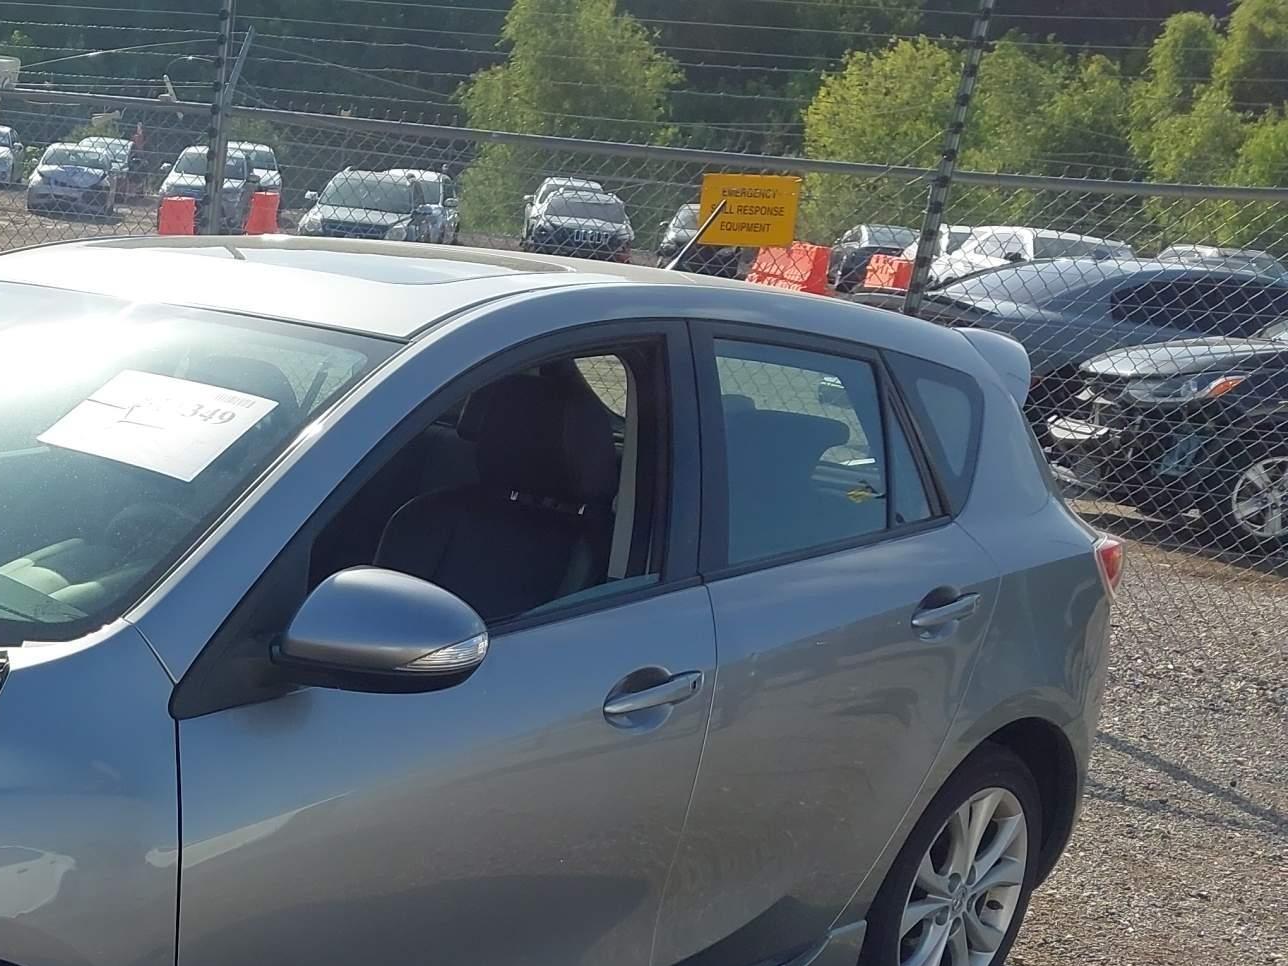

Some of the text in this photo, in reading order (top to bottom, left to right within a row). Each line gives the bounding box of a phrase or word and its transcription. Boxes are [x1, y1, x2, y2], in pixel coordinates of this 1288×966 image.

[722, 187, 778, 199] EMERGENCY
[710, 203, 785, 217] SLL RESPONSE
[720, 220, 772, 233] EQUIPMENT
